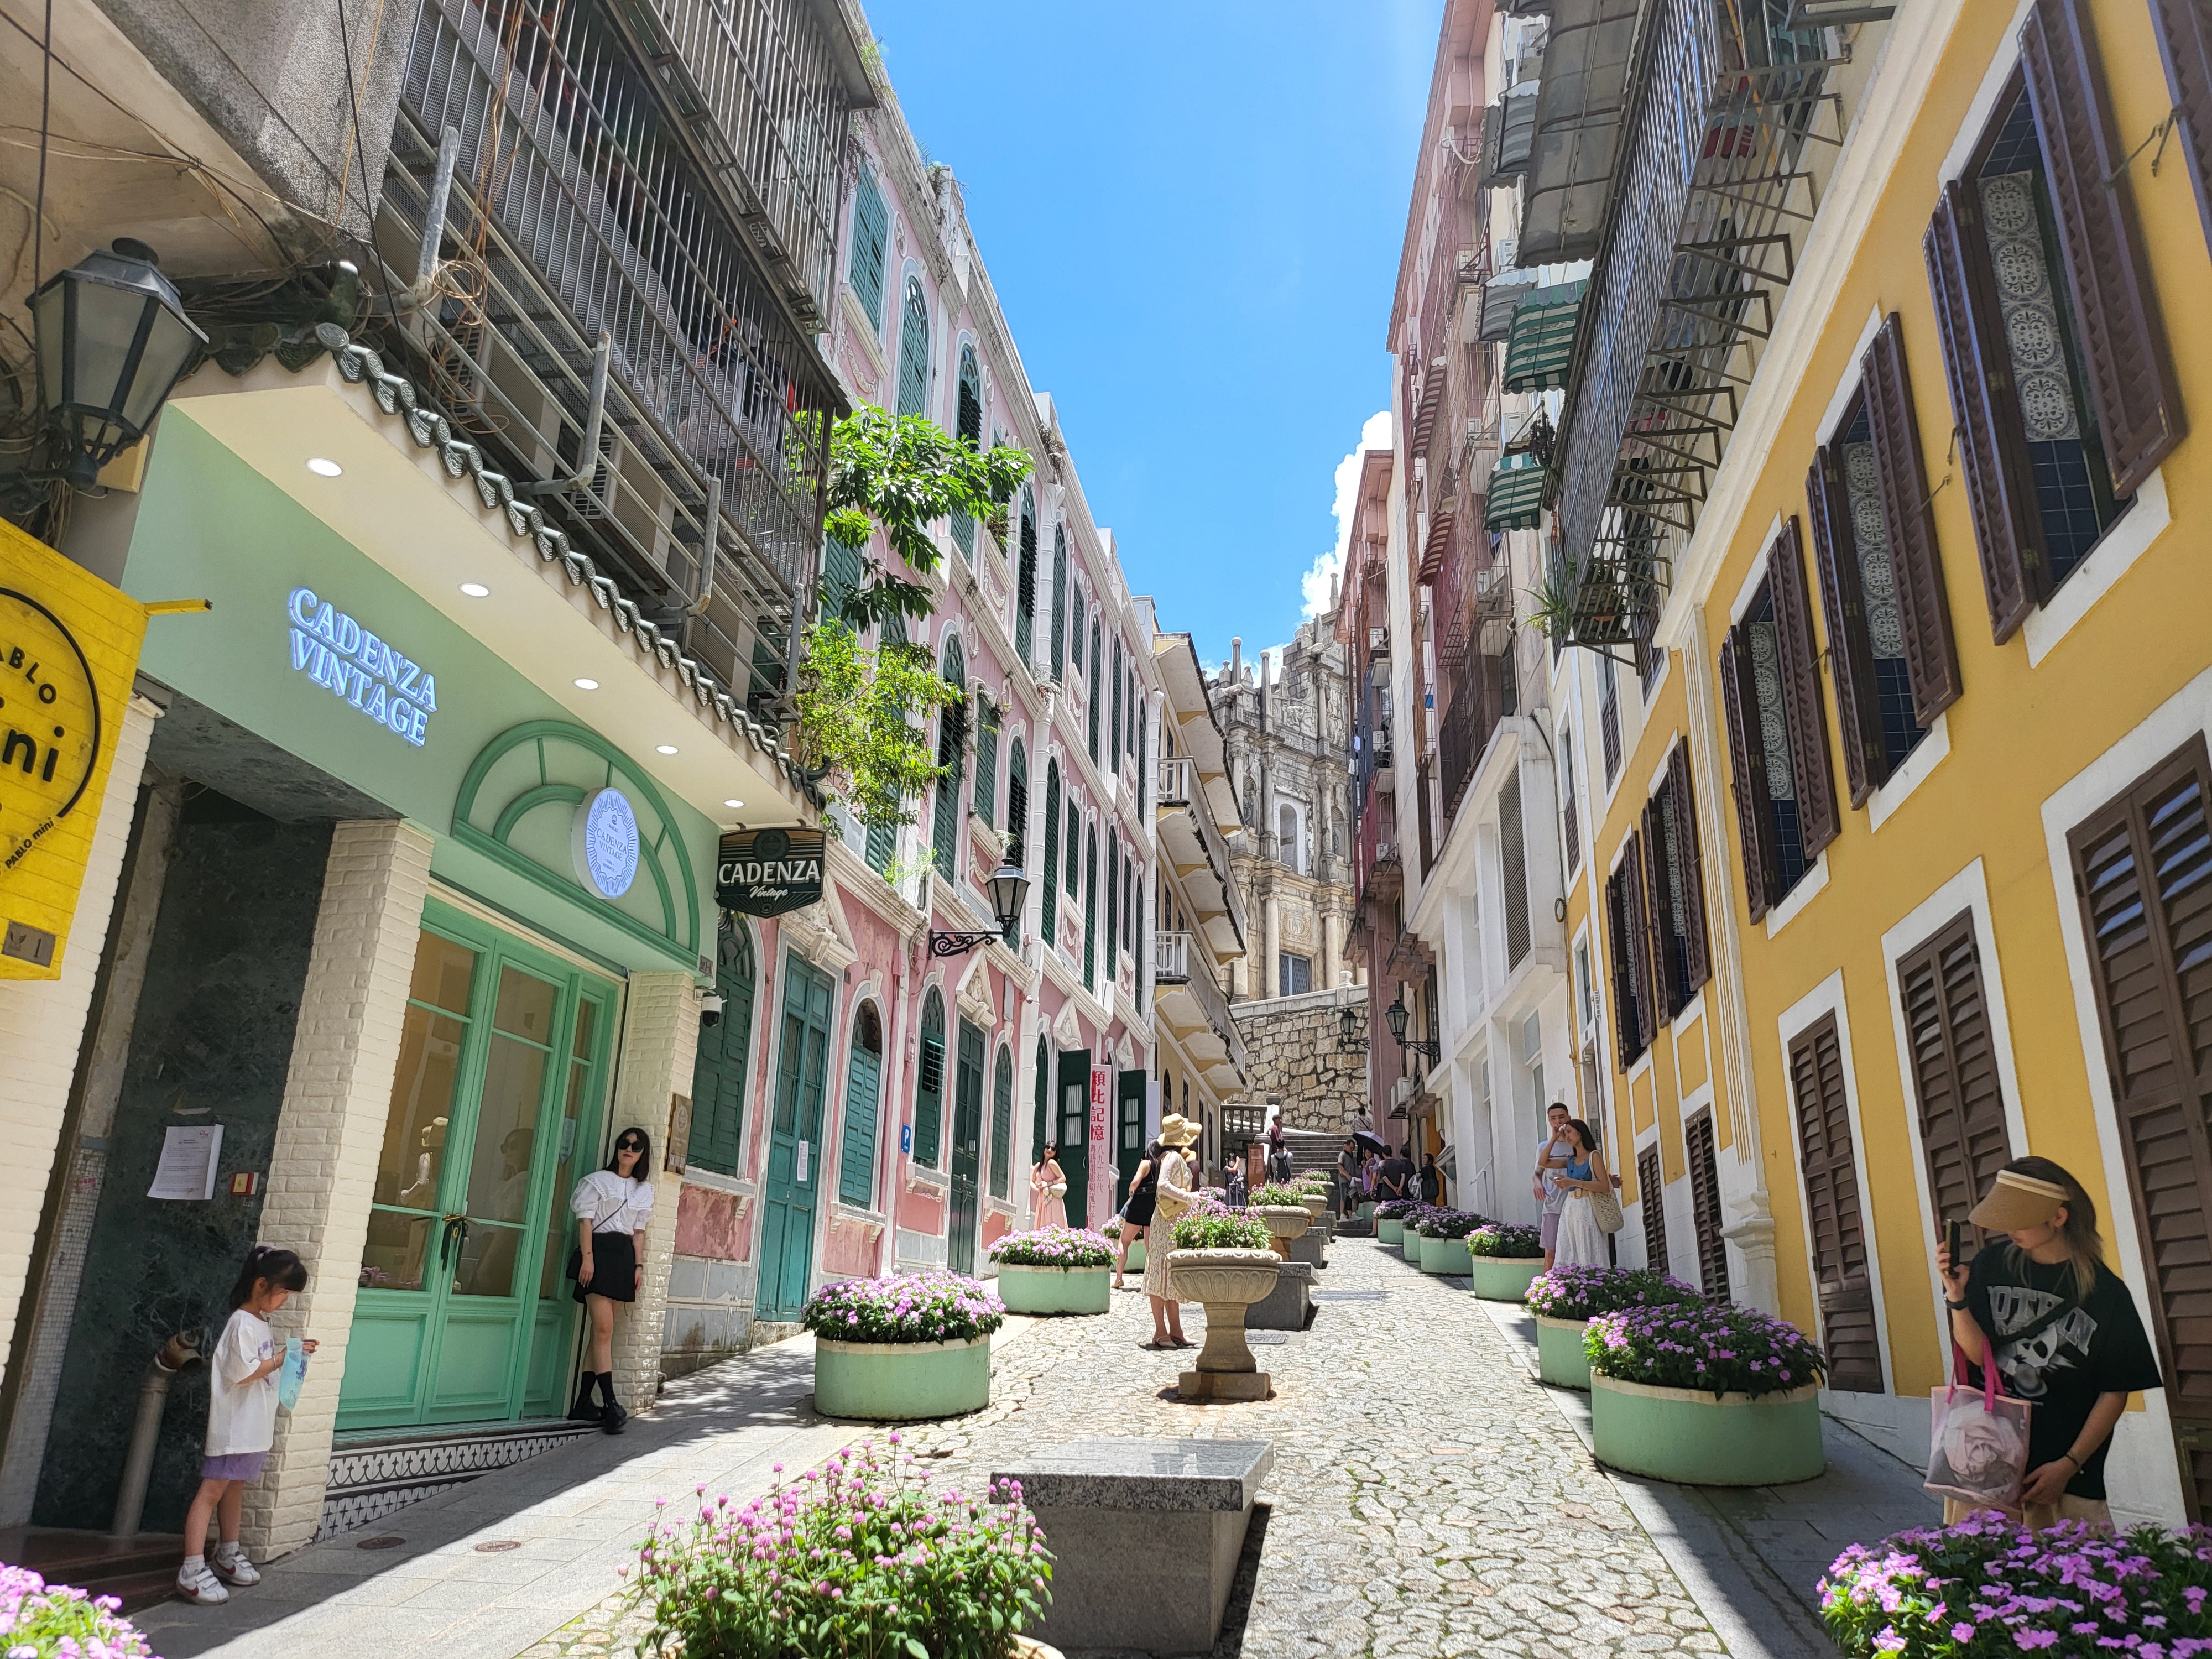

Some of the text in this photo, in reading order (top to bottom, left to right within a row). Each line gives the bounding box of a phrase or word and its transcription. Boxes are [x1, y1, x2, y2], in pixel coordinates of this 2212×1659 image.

[289, 587, 437, 712] CADENZA
[289, 627, 429, 747] VINTAGE
[5, 817, 54, 869] PABLO mini
[597, 828, 627, 854] CADENZA
[599, 840, 623, 862] VINTAGE
[719, 860, 821, 887] CADENZA
[749, 885, 789, 901] Vintage
[33, 937, 42, 958] 1
[904, 1128, 909, 1144] P
